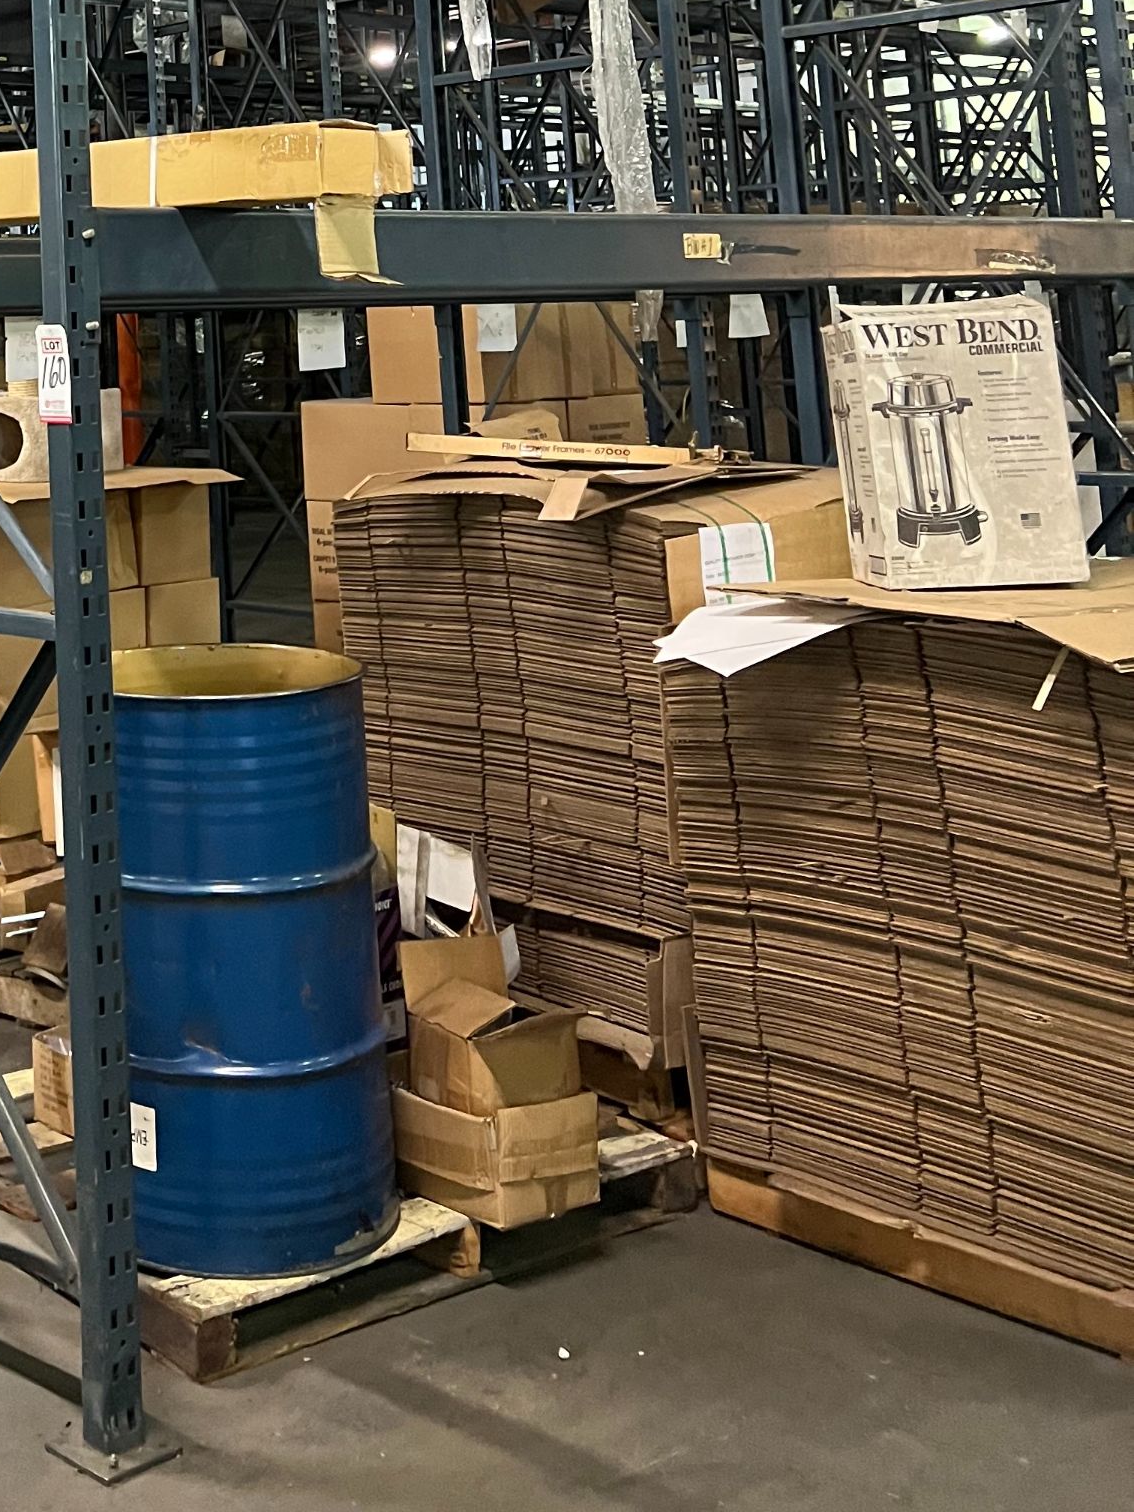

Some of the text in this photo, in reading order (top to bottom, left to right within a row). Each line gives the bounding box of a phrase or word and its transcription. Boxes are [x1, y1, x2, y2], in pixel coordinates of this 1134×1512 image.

[861, 323, 947, 350] WEST
[956, 318, 1039, 344] BEND
[44, 342, 60, 350] LOT
[969, 341, 1044, 356] COMMERCIAL
[42, 355, 66, 389] 160
